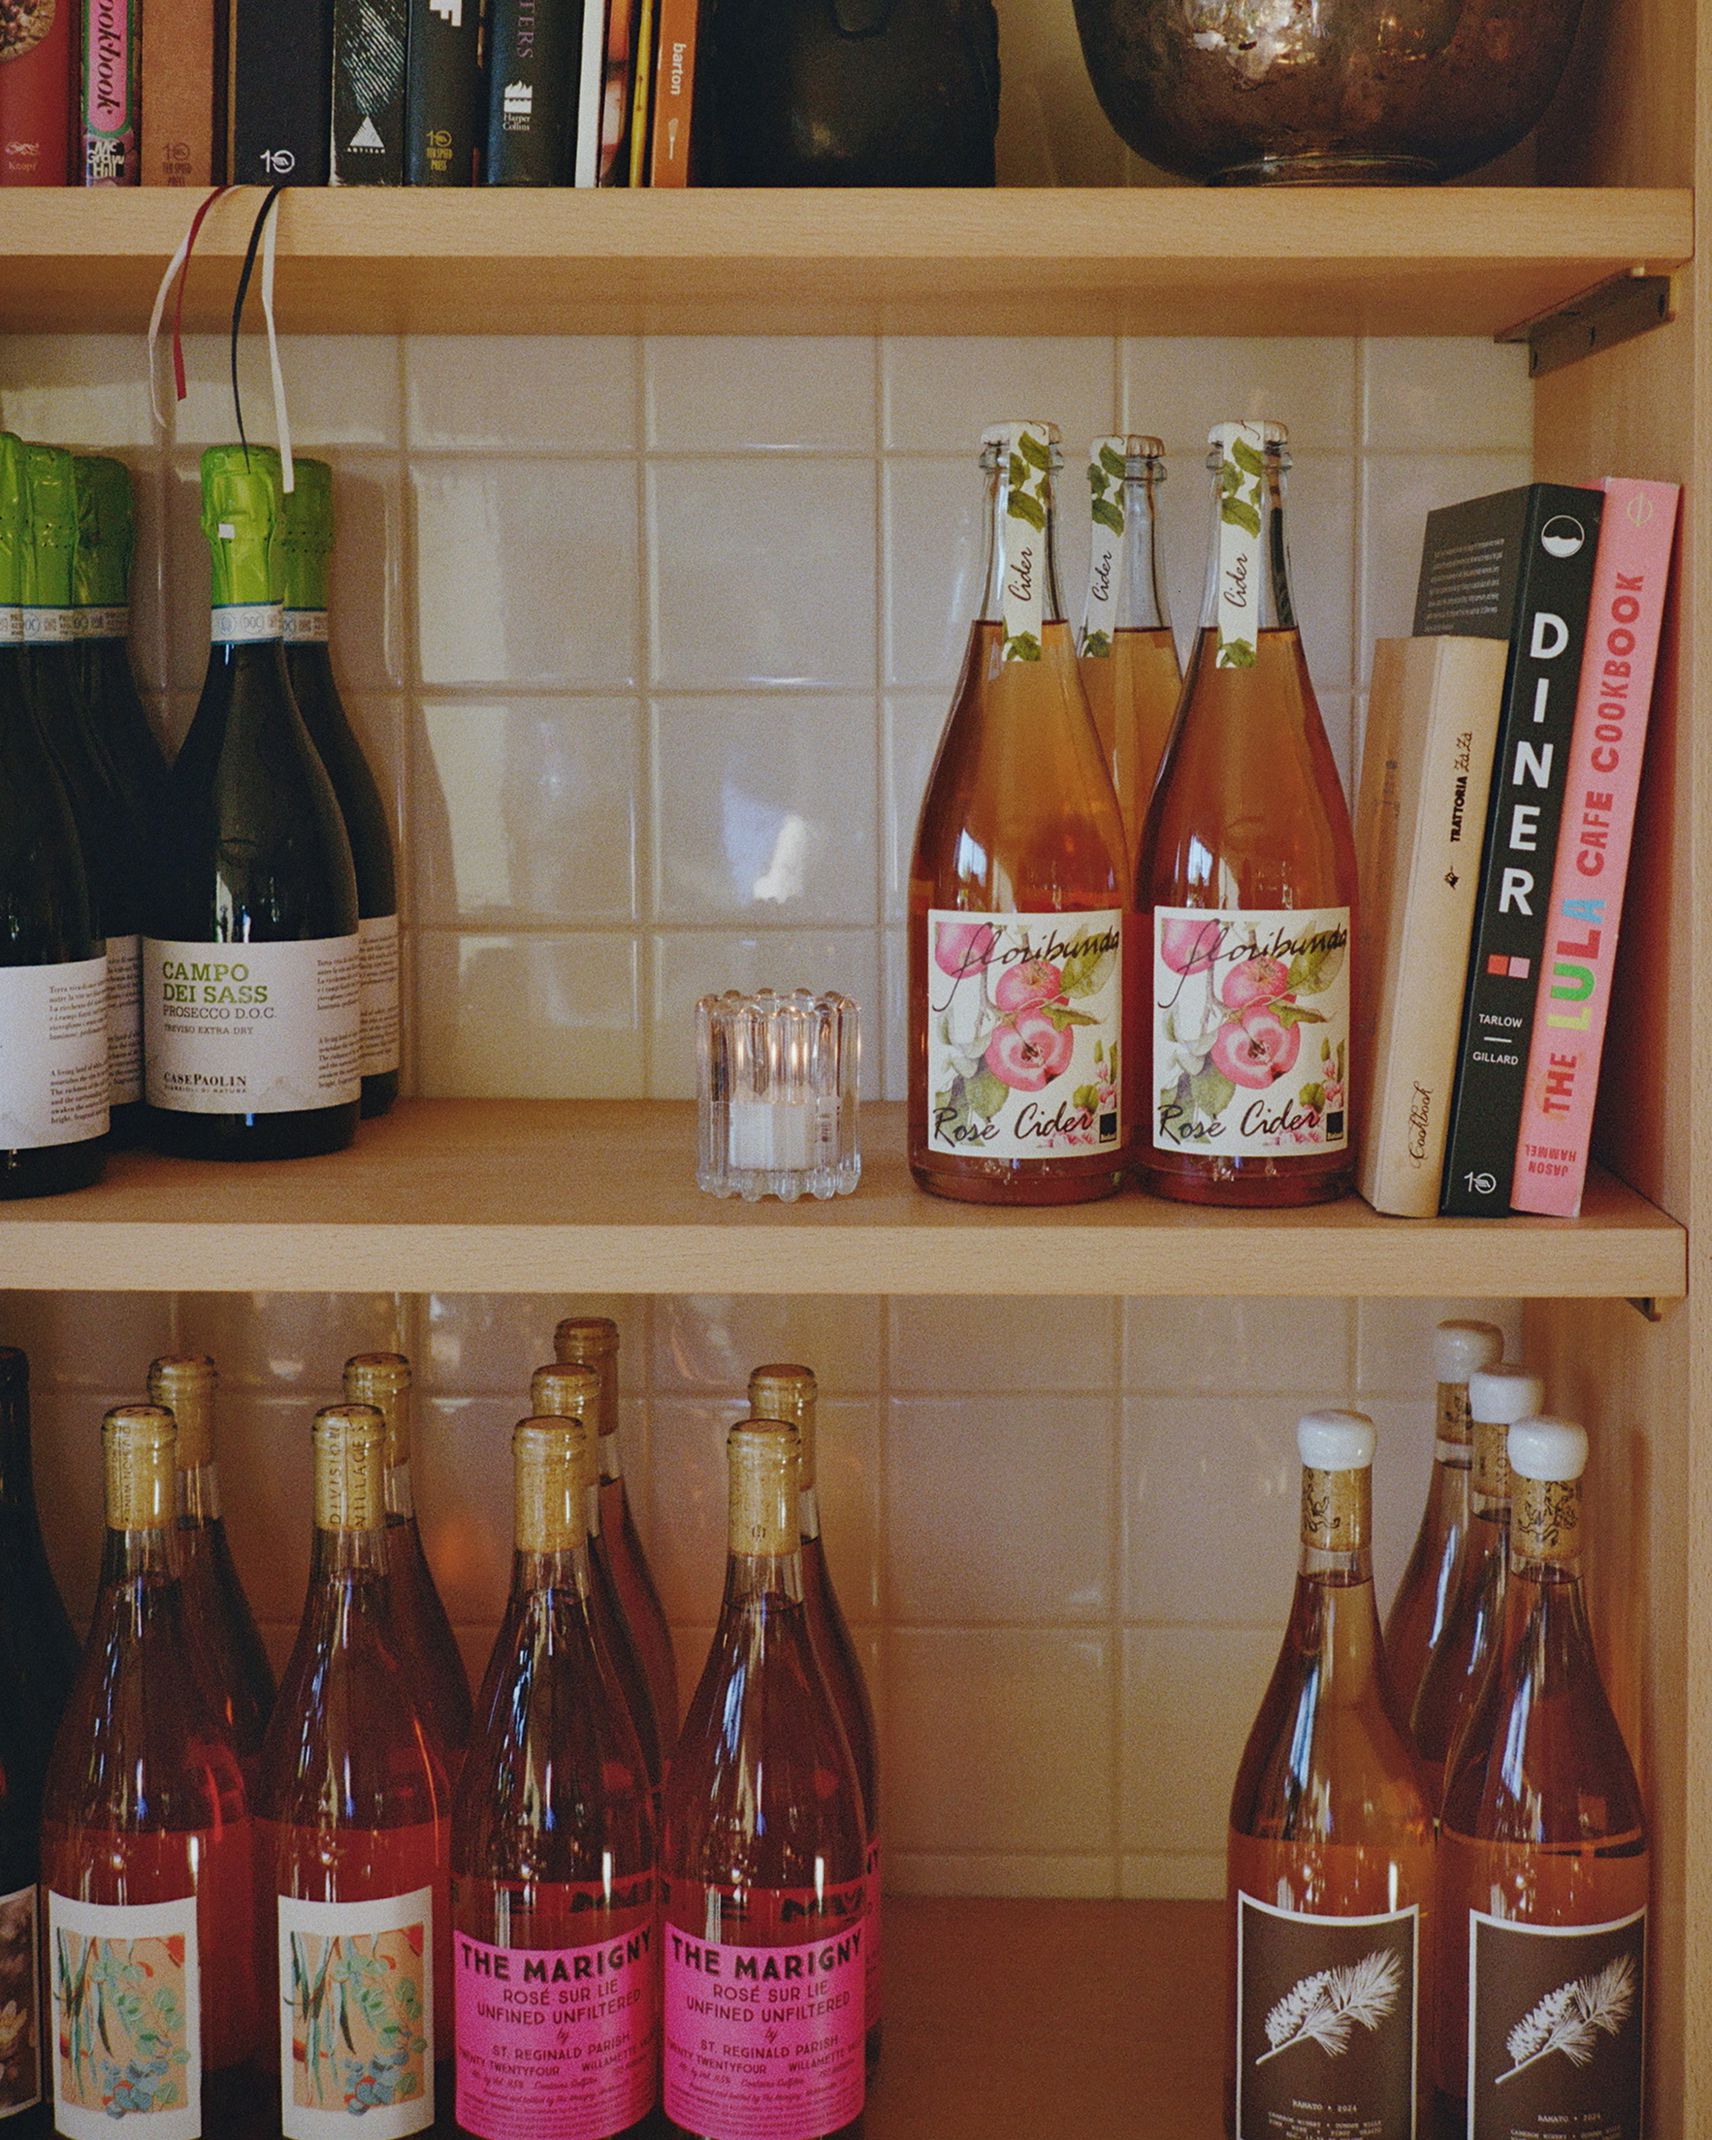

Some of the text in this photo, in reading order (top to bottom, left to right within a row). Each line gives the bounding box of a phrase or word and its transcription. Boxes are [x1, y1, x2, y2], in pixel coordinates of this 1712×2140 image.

[670, 43, 686, 95] barton
[503, 113, 530, 123] Harper
[503, 122, 530, 131] Collins
[1008, 546, 1033, 601] Cider
[1092, 550, 1112, 601] Cider
[1223, 552, 1248, 608] Cider
[1498, 611, 1570, 917] DINER
[1450, 775, 1467, 843] TRATTORIA
[1543, 572, 1645, 1114] THE LULA CAFE COOKBOOK
[162, 961, 249, 982] CAMPO
[162, 983, 268, 1004] DEI SASS
[163, 1004, 230, 1019] PROSECCO
[1479, 1014, 1523, 1029] TARLOW
[198, 1026, 229, 1035] EXTRA
[233, 1026, 254, 1035] DRY
[1472, 1050, 1519, 1066] GILLARD
[1013, 1101, 1093, 1140] Cider
[1239, 1098, 1321, 1137] Cider
[1410, 1081, 1433, 1169] Cookbook
[1525, 1144, 1577, 1161] HAMMEL
[1528, 1162, 1569, 1177] JASON
[461, 1930, 651, 1983] THE MARIGNY
[671, 1928, 862, 1981] THE MARIGNY
[503, 1979, 618, 2006] ROSÉ SUR LIE
[713, 1980, 828, 2003] ROSÉ SUR LIE
[477, 1989, 641, 2025] UNFINED UNFILTERED
[687, 1991, 850, 2023] UNFINED UNFILTERED
[492, 2044, 512, 2058] ST.
[515, 2046, 582, 2061] REGINALD
[588, 2032, 630, 2055] PARISH
[557, 2027, 569, 2045] by
[701, 2039, 718, 2054] ST.
[723, 2044, 790, 2059] REGINALD
[795, 2034, 839, 2056] PARISH
[765, 2027, 778, 2044] by
[490, 2061, 560, 2076] TWENTYFOUR
[697, 2055, 767, 2074] TWENTYFOUR
[788, 2048, 845, 2072] WILLAMETTE
